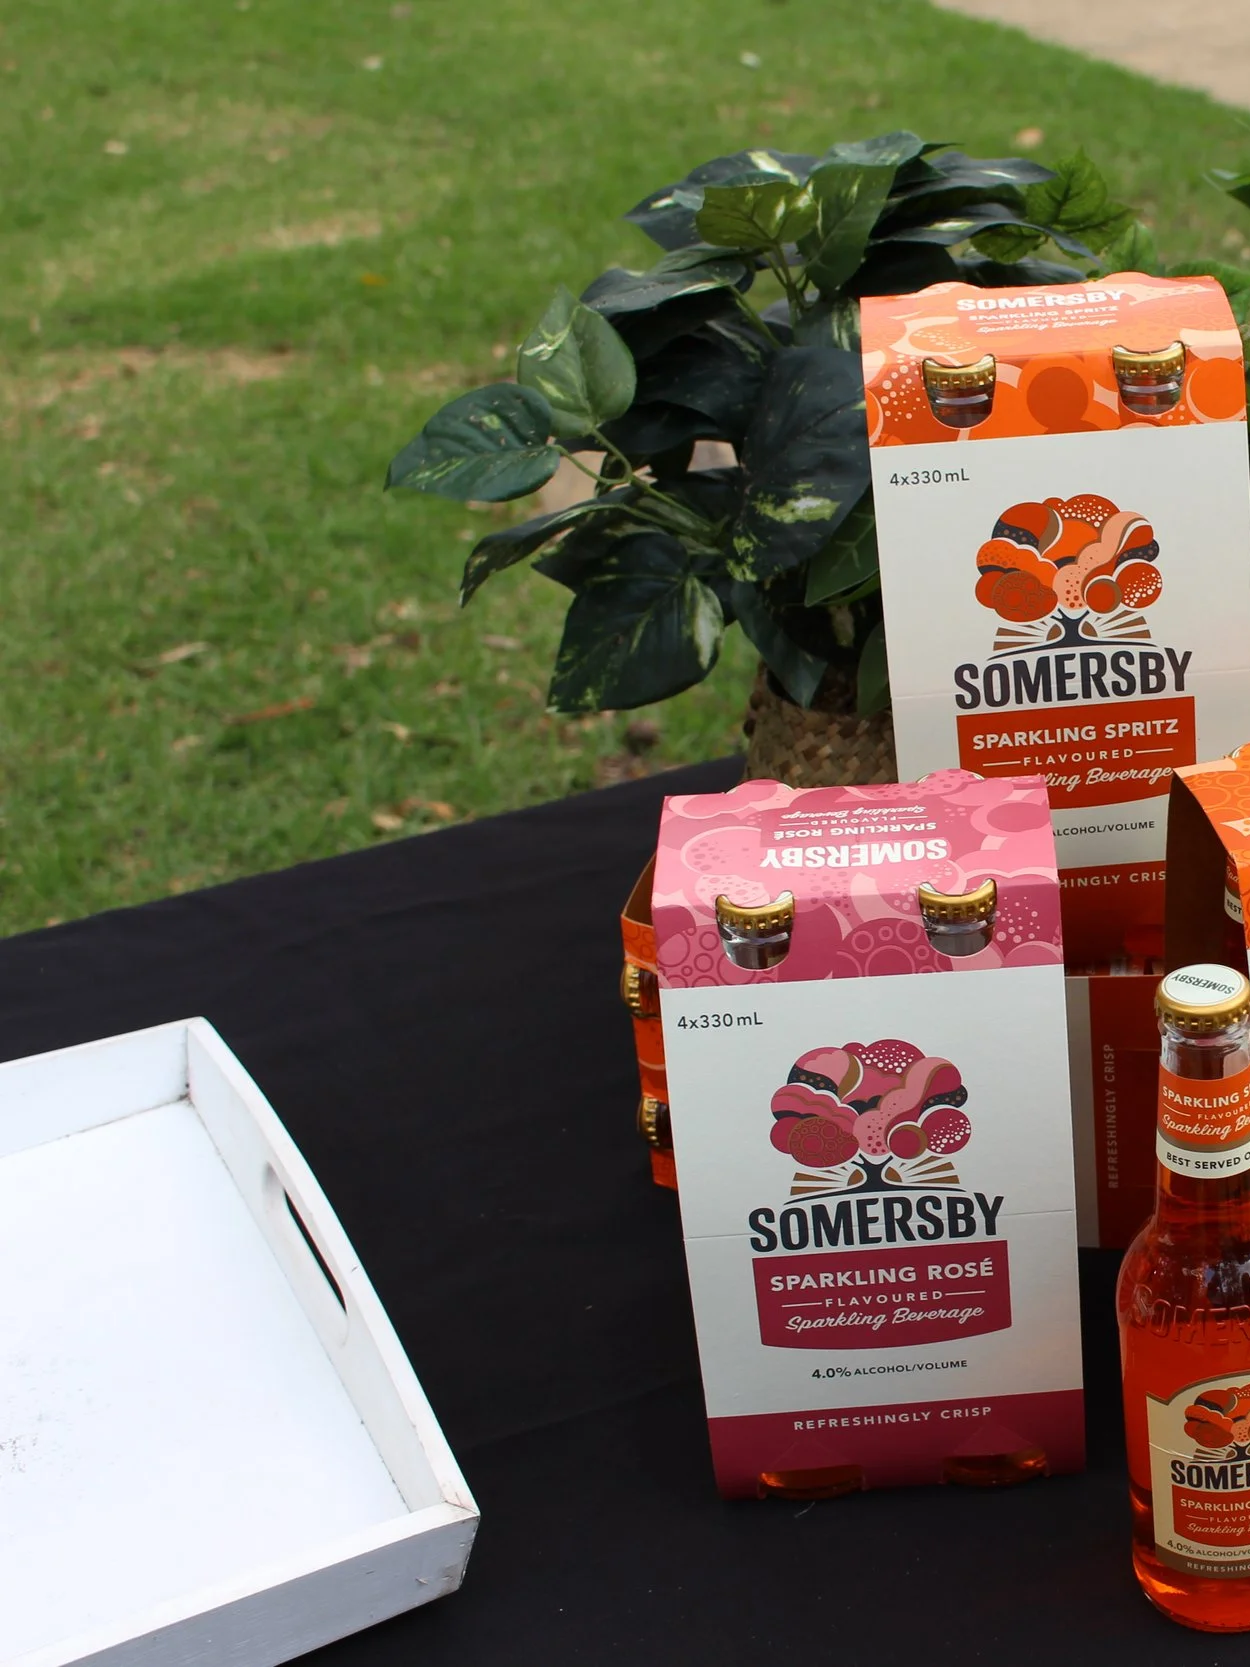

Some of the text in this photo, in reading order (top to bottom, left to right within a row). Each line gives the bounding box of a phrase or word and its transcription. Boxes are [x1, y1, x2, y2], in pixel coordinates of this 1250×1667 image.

[956, 290, 1126, 311] SOMERSBY
[968, 305, 1119, 321] SPARKLING SPRITZ
[890, 468, 970, 487] 4x330 mL
[954, 647, 1192, 710] SOMERSBY
[972, 719, 1178, 750] SPARKLING SPRITZ
[1024, 748, 1134, 766] FLAVOURED
[1086, 767, 1173, 785] Beverage
[852, 805, 926, 816] Sparkling
[774, 822, 936, 840] SPARKLING ROSÉ
[811, 816, 896, 826] FLAVOURED
[759, 839, 947, 869] SOMERSBY
[1129, 870, 1166, 883] CRIS
[1171, 972, 1235, 995] SOMERSBY
[677, 1011, 763, 1030] 4x330 mL
[1162, 1086, 1240, 1109] SPARKLING
[1104, 1043, 1118, 1188] REFRESHINGLY CRISP
[1162, 1114, 1231, 1140] Sparkling
[1167, 1152, 1191, 1167] BEST
[1195, 1157, 1241, 1169] SERVED
[748, 1192, 1004, 1253] SOMERSBY
[770, 1257, 994, 1292] SPARKLING ROSÉ
[825, 1290, 943, 1308] FLAVOURED
[784, 1305, 985, 1333] Sparkling Beverage
[811, 1359, 968, 1380] 4.0% ALCOHOL/VOLUME
[794, 1406, 992, 1431] REFRESHINGLY CRISP
[1187, 1522, 1245, 1536] Sparkling
[1167, 1540, 1195, 1555] 4.0%
